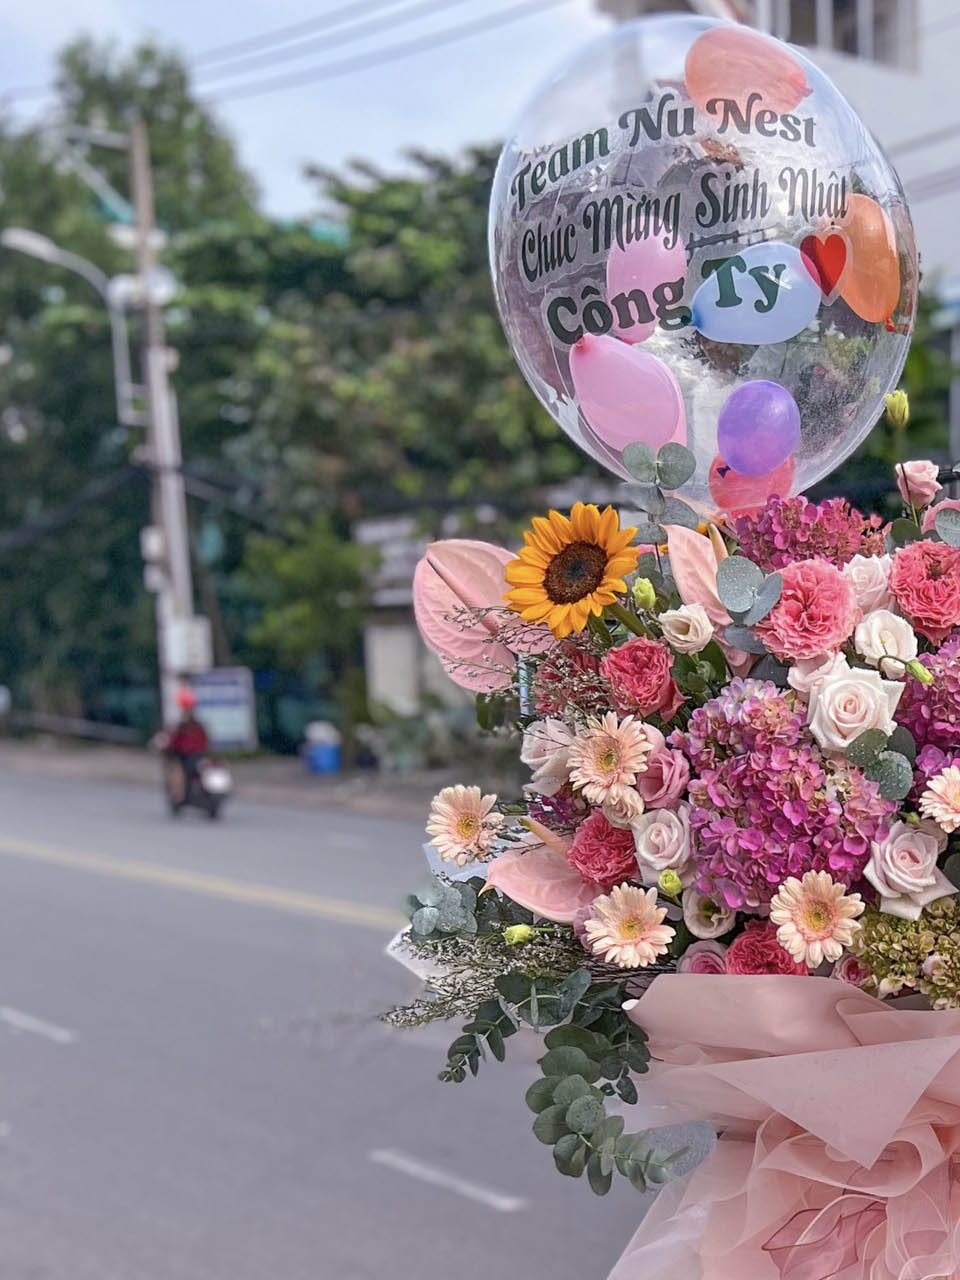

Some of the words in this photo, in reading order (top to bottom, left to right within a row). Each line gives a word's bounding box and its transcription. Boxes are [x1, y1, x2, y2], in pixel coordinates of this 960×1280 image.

[511, 127, 610, 212] Team
[618, 93, 695, 147] Nu
[705, 93, 817, 147] Nest
[521, 221, 577, 283] Chúc
[583, 192, 681, 254] Mừng
[695, 168, 772, 228] Sinh
[778, 167, 848, 227] Nhật
[546, 277, 692, 345] Công
[702, 255, 786, 313] Ty
